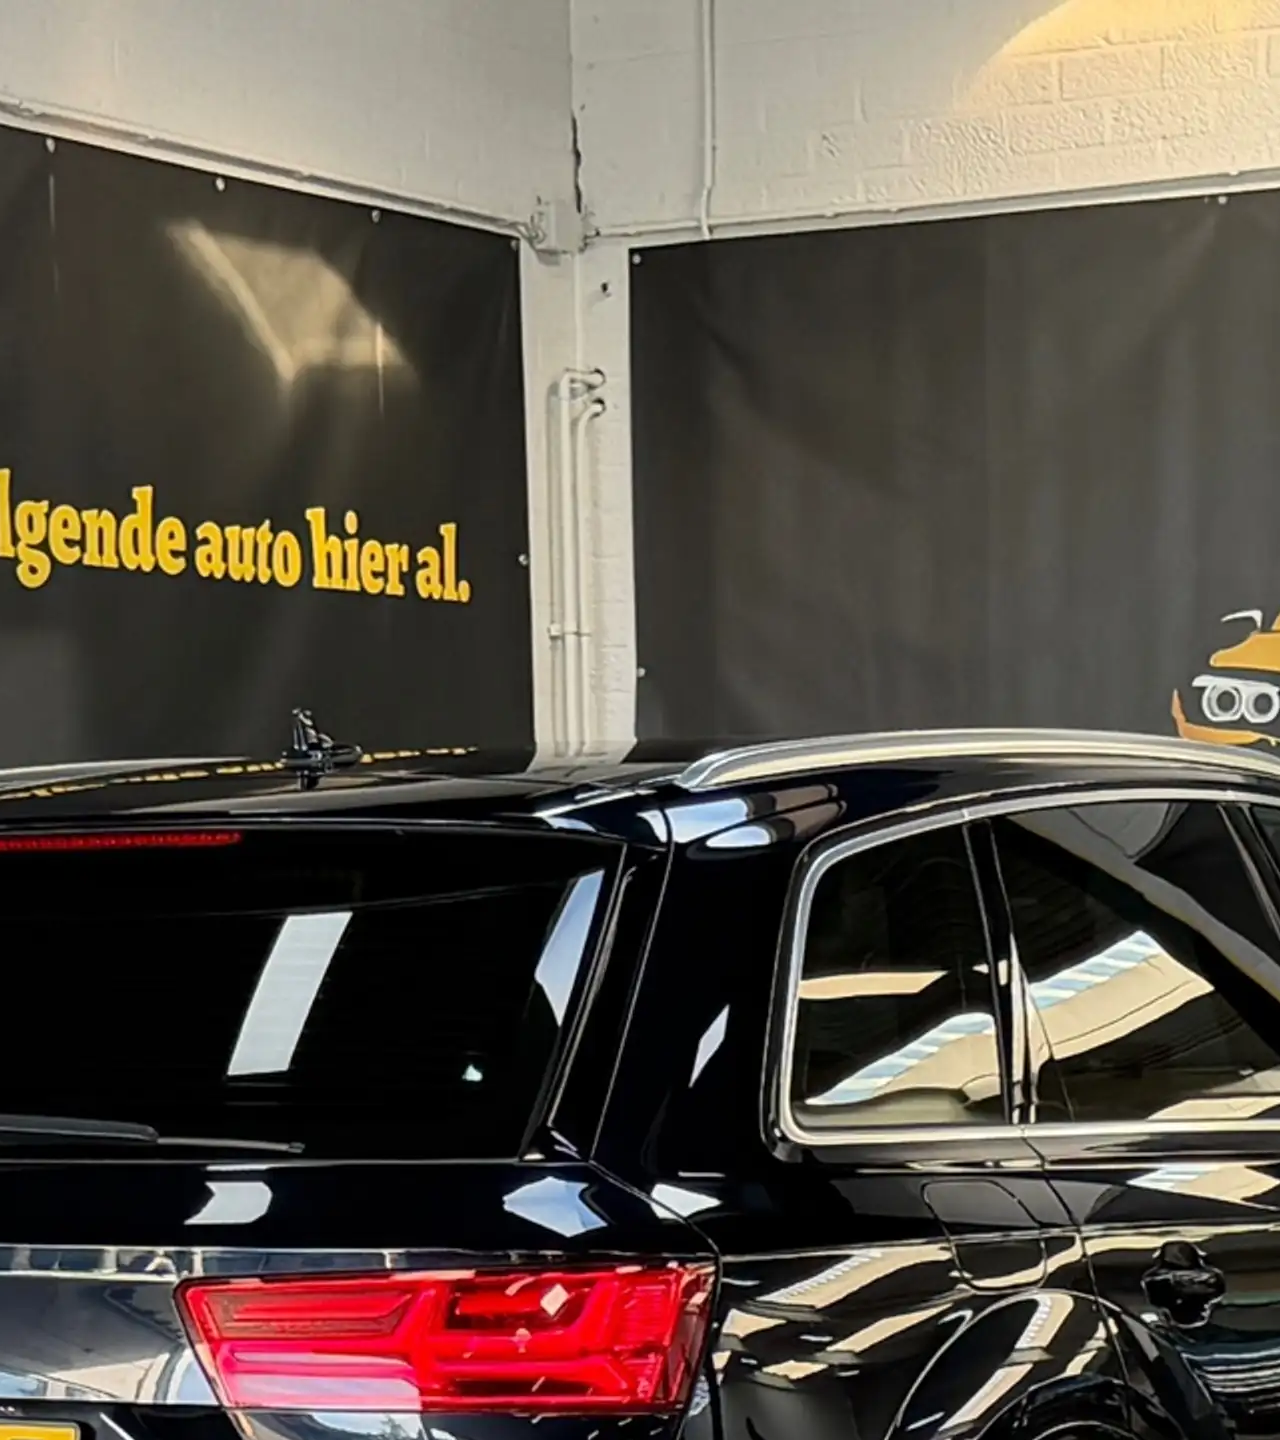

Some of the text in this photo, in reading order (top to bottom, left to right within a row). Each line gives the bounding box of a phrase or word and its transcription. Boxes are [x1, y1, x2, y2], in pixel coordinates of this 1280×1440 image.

[195, 519, 303, 588] auto
[305, 506, 410, 598] hier
[415, 522, 472, 603] al.
